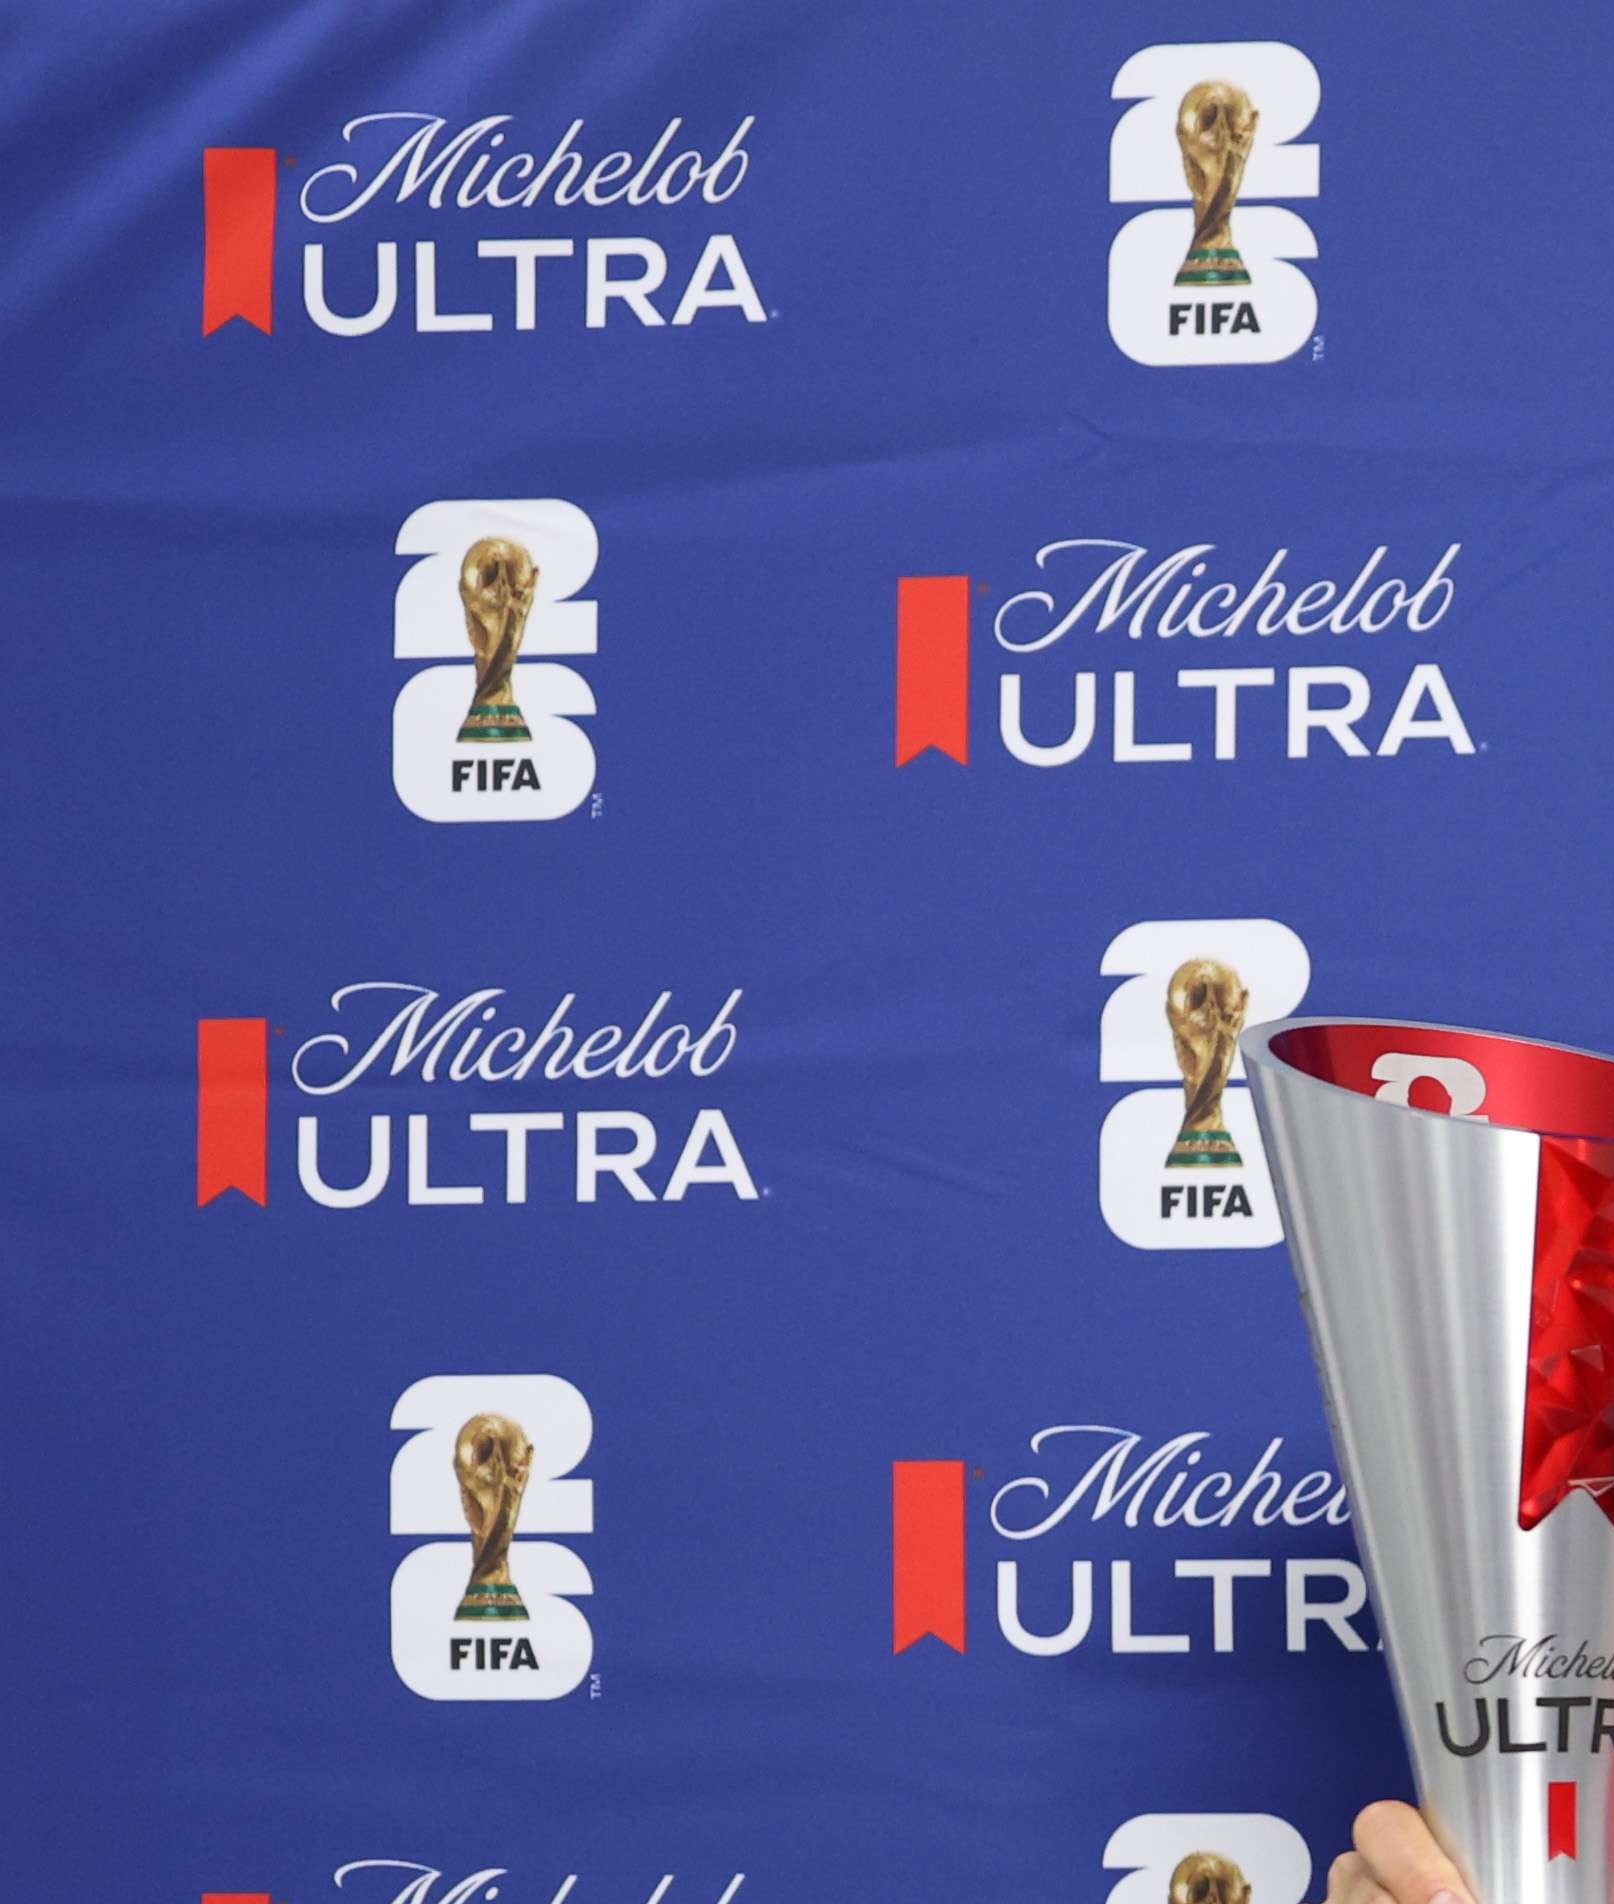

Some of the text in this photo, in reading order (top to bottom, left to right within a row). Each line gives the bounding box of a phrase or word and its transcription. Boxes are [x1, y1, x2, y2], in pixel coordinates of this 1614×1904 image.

[300, 112, 755, 223] Michelob
[304, 234, 767, 336] ULTRA
[1169, 302, 1261, 336] FIFA
[994, 539, 1461, 653] Michelob
[1000, 664, 1476, 767] ULTRA
[452, 758, 541, 793] FIFA
[292, 982, 743, 1095] Michelob
[298, 1109, 759, 1208] ULTRA
[1161, 1184, 1251, 1219] FIFA
[990, 1424, 1352, 1540] Miche
[450, 1637, 540, 1671] FIFA
[997, 1559, 1386, 1657] ULTR
